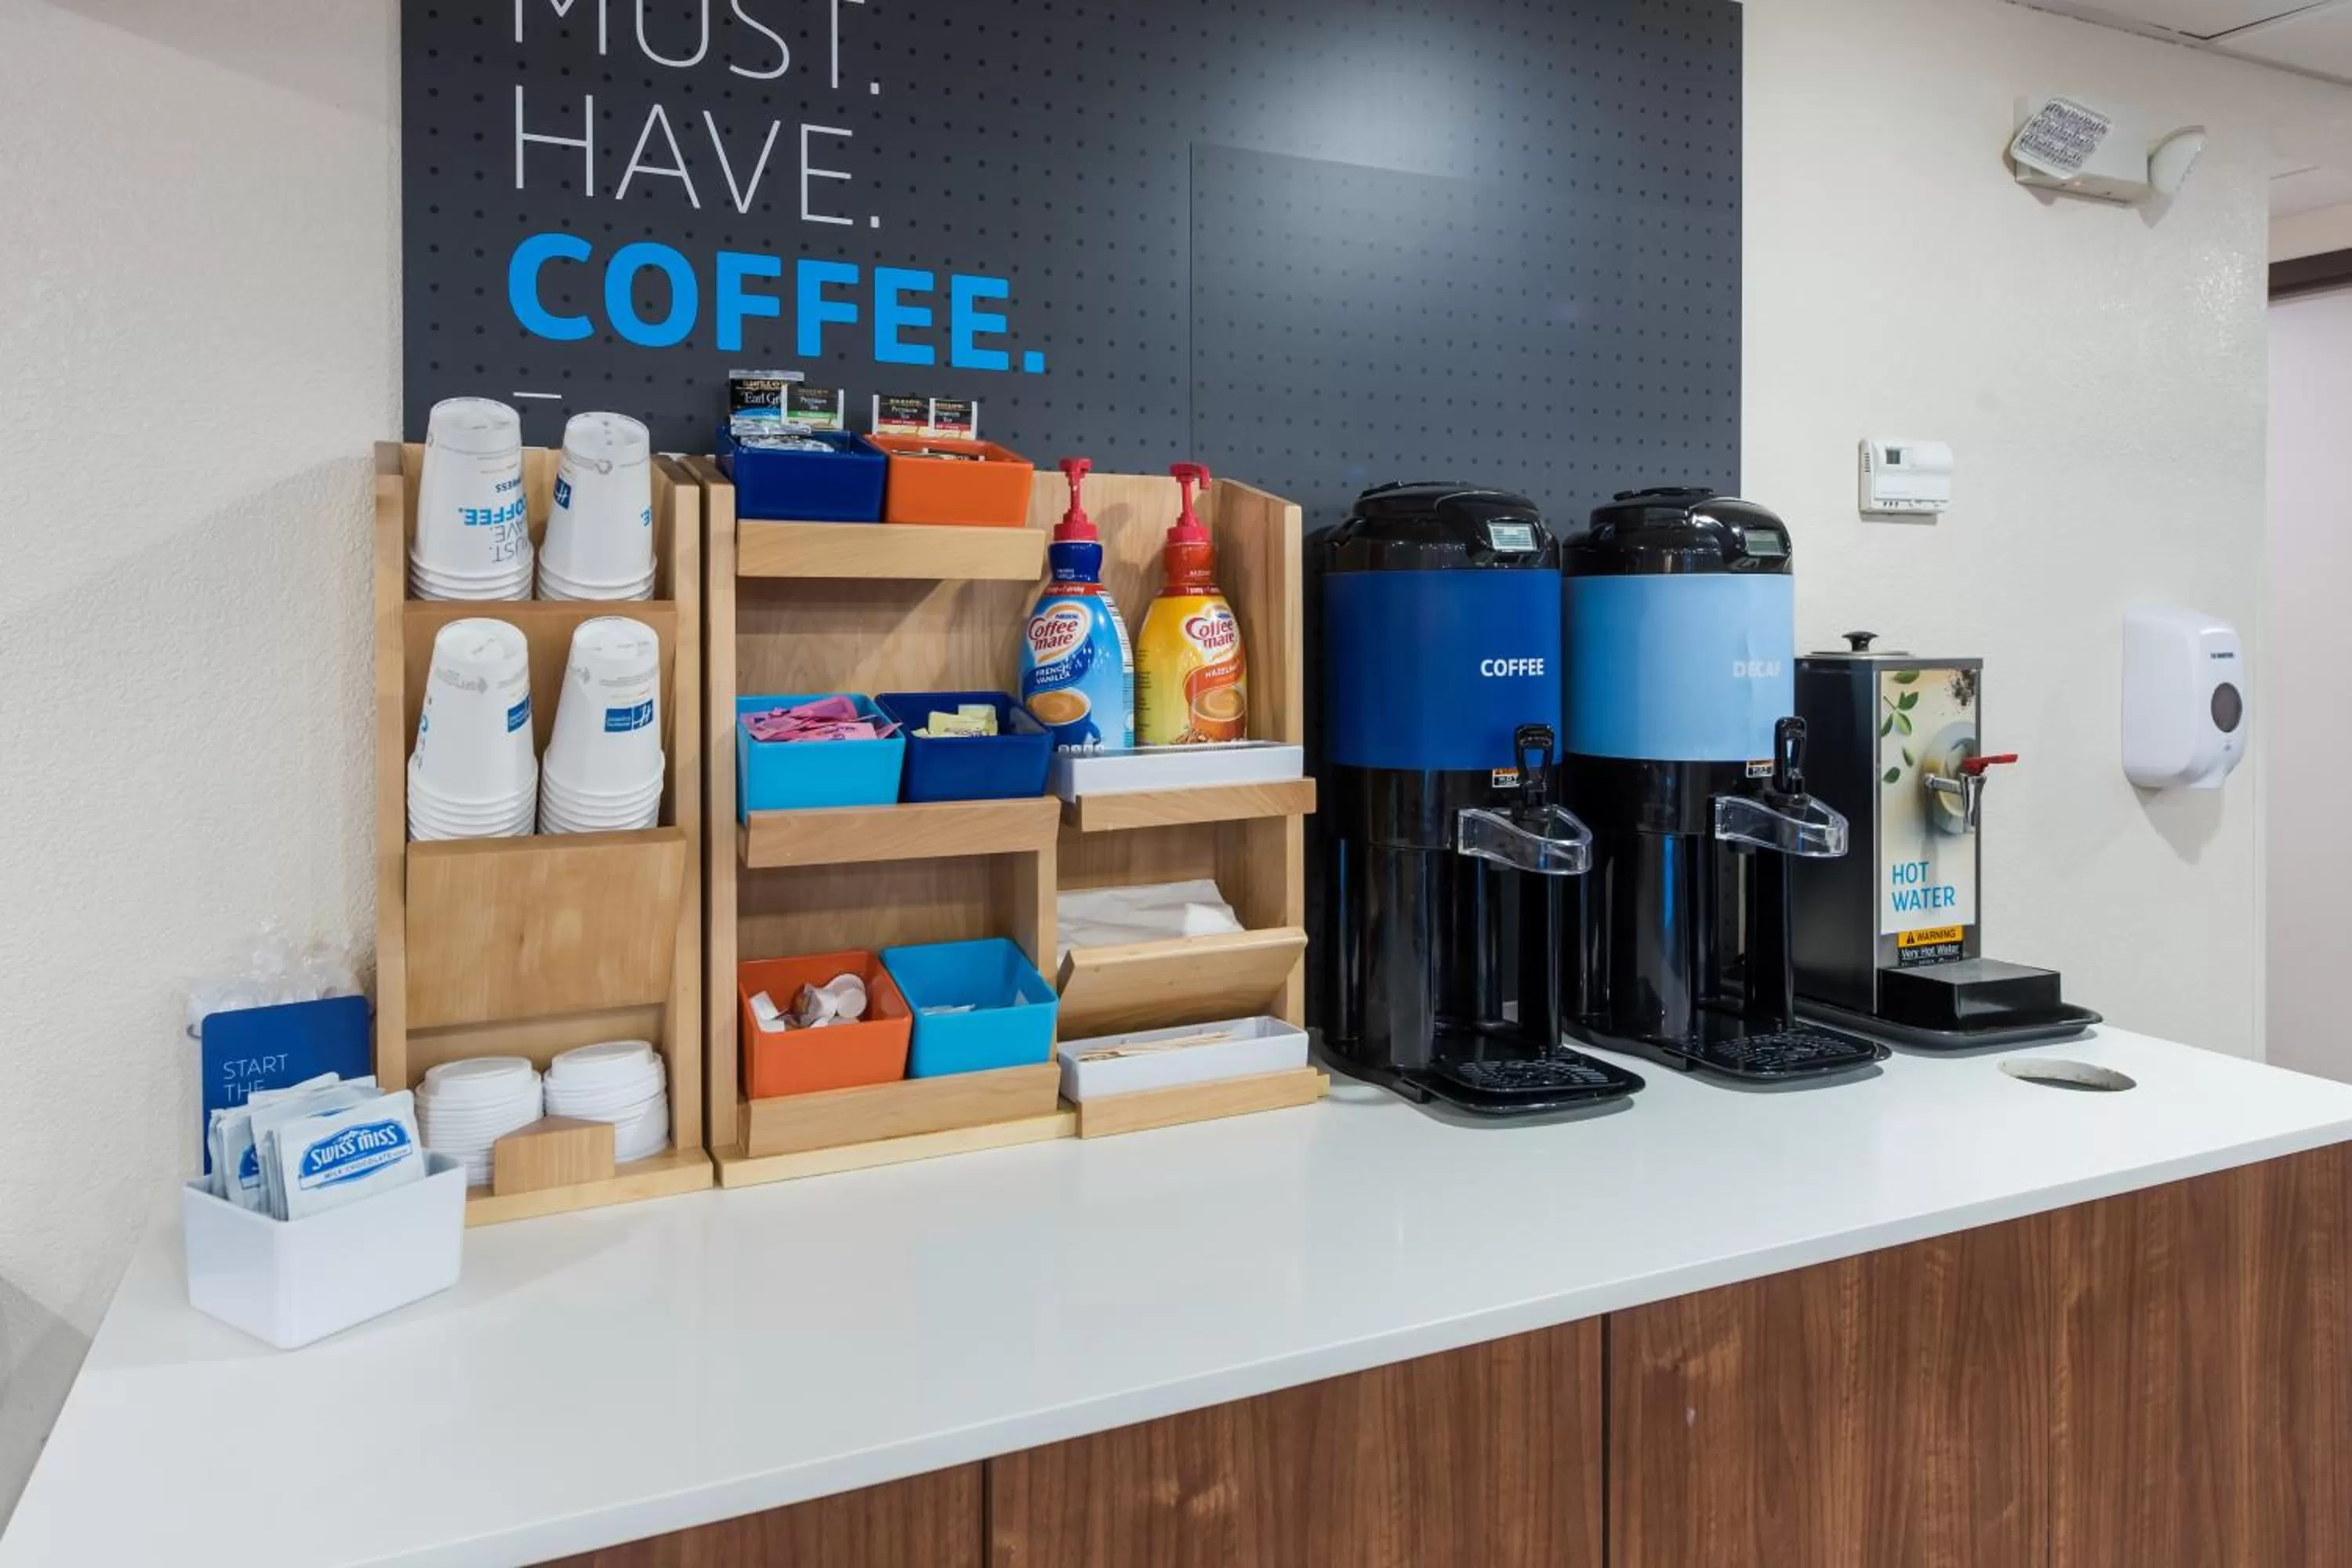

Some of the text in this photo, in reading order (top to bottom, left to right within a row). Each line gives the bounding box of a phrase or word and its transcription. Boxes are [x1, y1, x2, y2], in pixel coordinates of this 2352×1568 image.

[514, 85, 880, 228] HAVE.
[507, 232, 1046, 374] COFFEE.
[458, 495, 527, 525] OFFEE.
[489, 520, 524, 543] AVE.
[489, 536, 528, 562] UST.
[1028, 617, 1080, 641] Coffee
[1185, 617, 1233, 641] Coffee
[1203, 632, 1235, 650] mate
[1034, 633, 1073, 652] mate
[1480, 658, 1544, 677] COFFEE
[1732, 660, 1782, 678] DECAF
[1891, 861, 1929, 885] HOT
[1890, 885, 1956, 913] WATER
[1916, 928, 1957, 942] WARNING
[223, 1053, 289, 1080] START
[223, 1079, 265, 1102] THE
